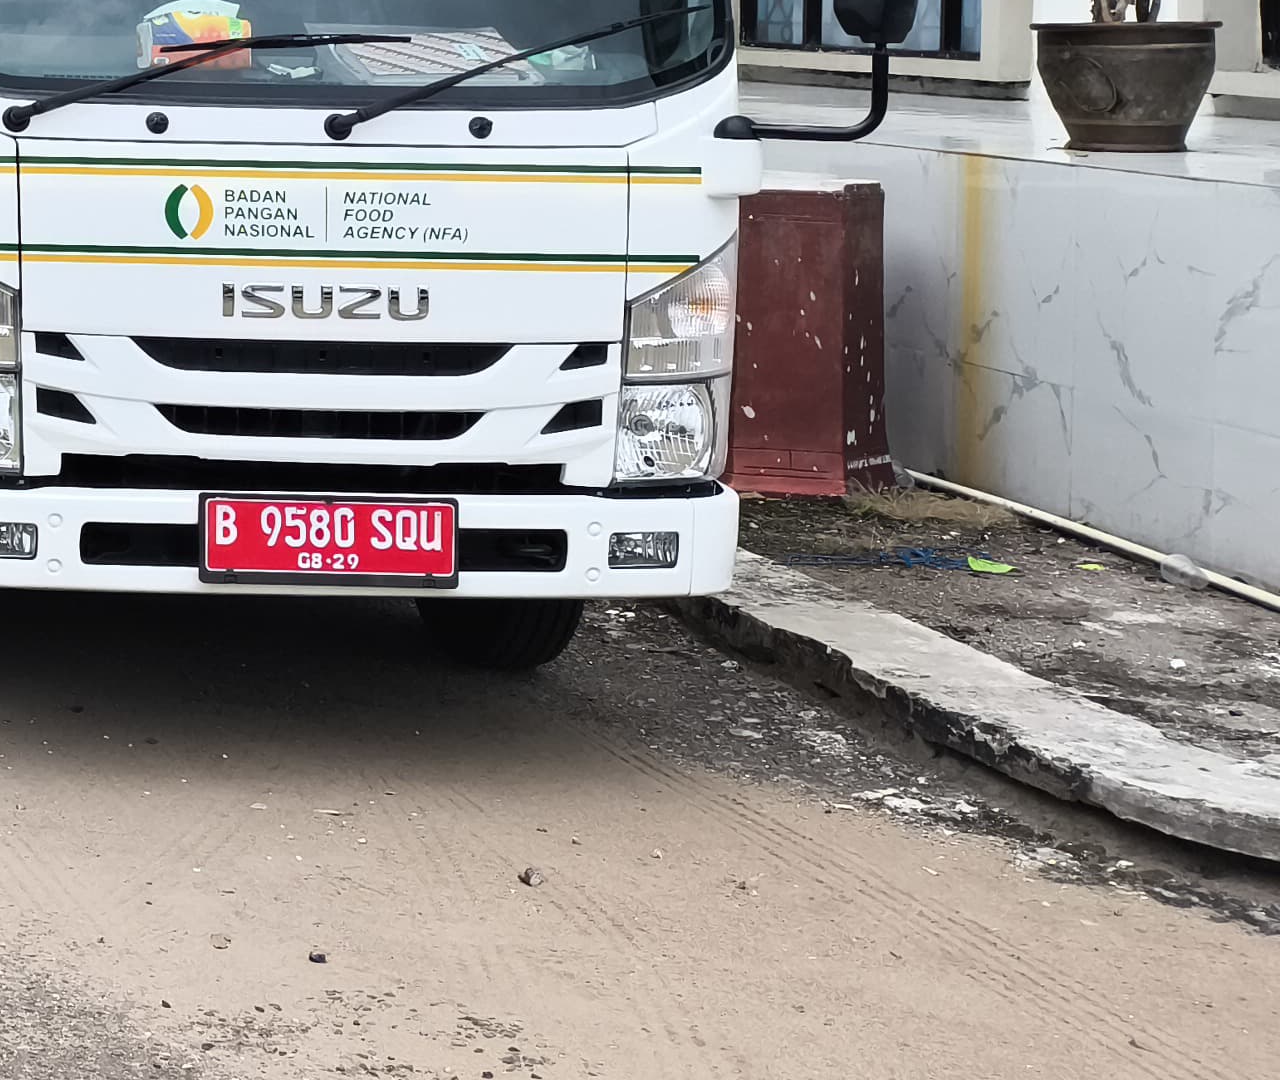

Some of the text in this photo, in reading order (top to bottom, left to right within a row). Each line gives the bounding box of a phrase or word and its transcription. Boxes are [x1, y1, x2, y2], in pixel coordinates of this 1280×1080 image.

[224, 189, 287, 204] BADAN
[343, 191, 432, 206] NATIONAL
[224, 207, 298, 221] PANGAN
[343, 209, 394, 223] FOOD
[224, 224, 315, 238] NASIONAL
[343, 226, 469, 243] AGENCY (NFA)
[222, 282, 430, 321] ISUZU
[215, 504, 443, 552] B 9580 SQU
